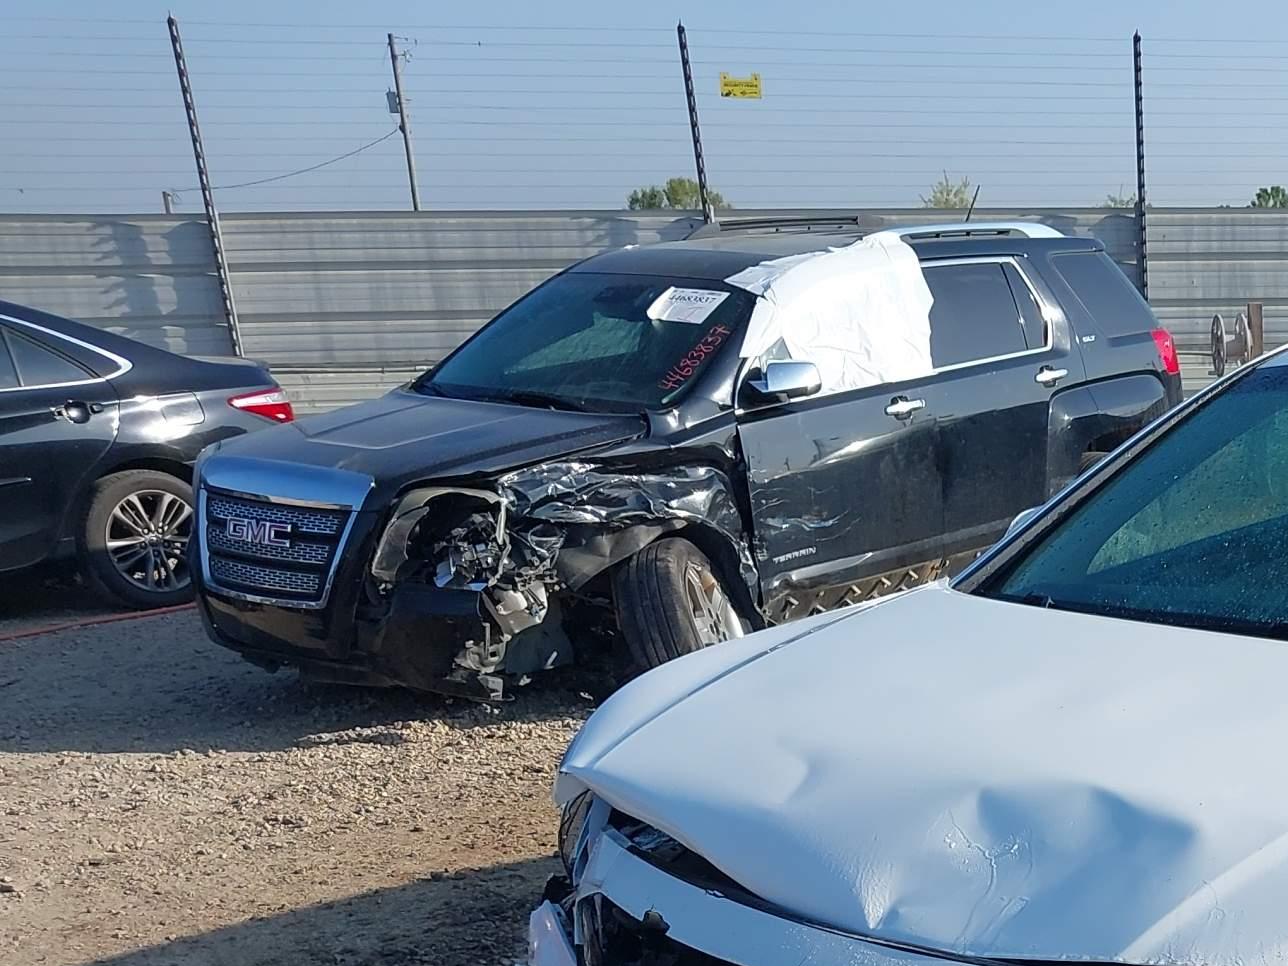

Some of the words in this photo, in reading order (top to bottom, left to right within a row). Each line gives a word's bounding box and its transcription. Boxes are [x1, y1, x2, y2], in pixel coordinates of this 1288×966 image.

[658, 324, 731, 390] 44683837
[227, 517, 292, 548] GMC
[772, 547, 816, 564] TERRAIN
